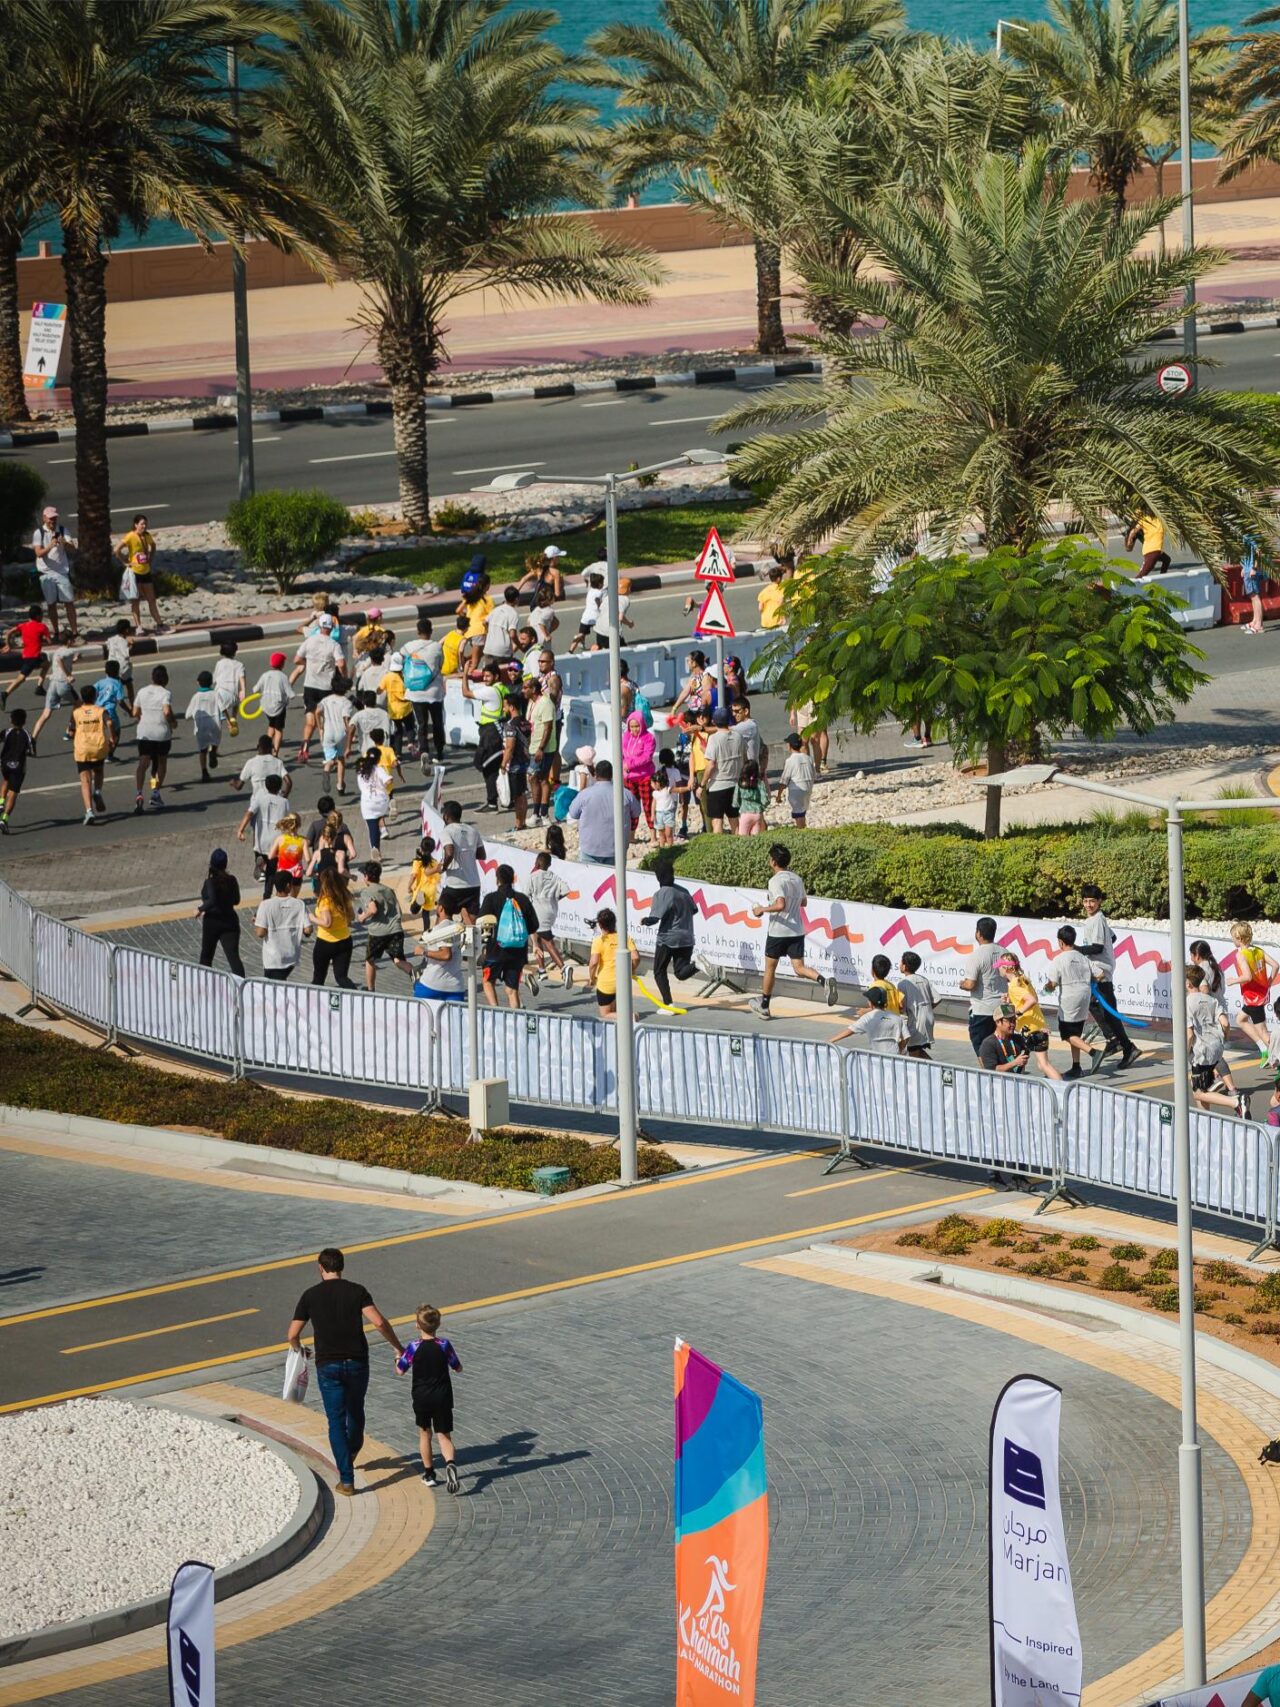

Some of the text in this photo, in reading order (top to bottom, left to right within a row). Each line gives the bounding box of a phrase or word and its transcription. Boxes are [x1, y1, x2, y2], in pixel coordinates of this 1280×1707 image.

[715, 934, 761, 951] khaimah
[923, 961, 966, 977] khaima
[1128, 982, 1141, 995] al
[1003, 1510, 1047, 1546] مرجان
[1003, 1537, 1068, 1585] Marjan
[679, 1600, 741, 1682] Khaimah
[1026, 1635, 1073, 1656] Inspired
[694, 1657, 740, 1696] MARATHON
[1011, 1672, 1027, 1687] the
[1030, 1677, 1060, 1692] Land
